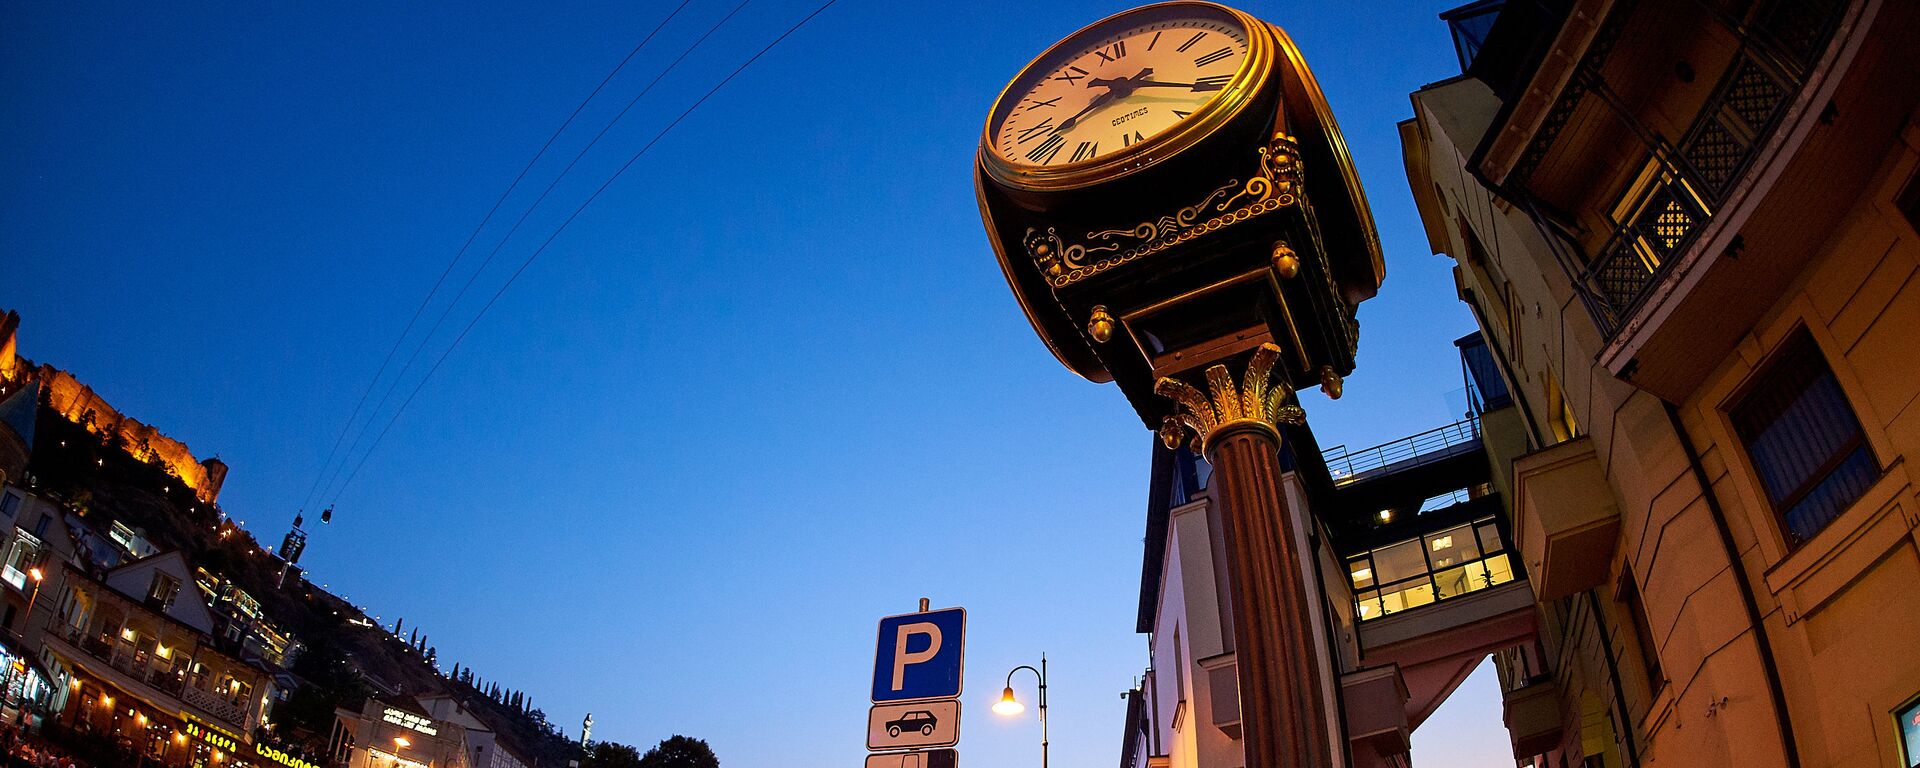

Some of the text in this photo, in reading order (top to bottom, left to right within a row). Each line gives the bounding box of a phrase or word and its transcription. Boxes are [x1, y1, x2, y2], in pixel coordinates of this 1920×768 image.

[1176, 31, 1208, 53] II
[1095, 40, 1126, 67] XII
[1194, 46, 1234, 67] III
[1055, 66, 1089, 86] XI
[1026, 96, 1062, 111] X
[1018, 117, 1053, 144] IX
[891, 621, 943, 691] P
